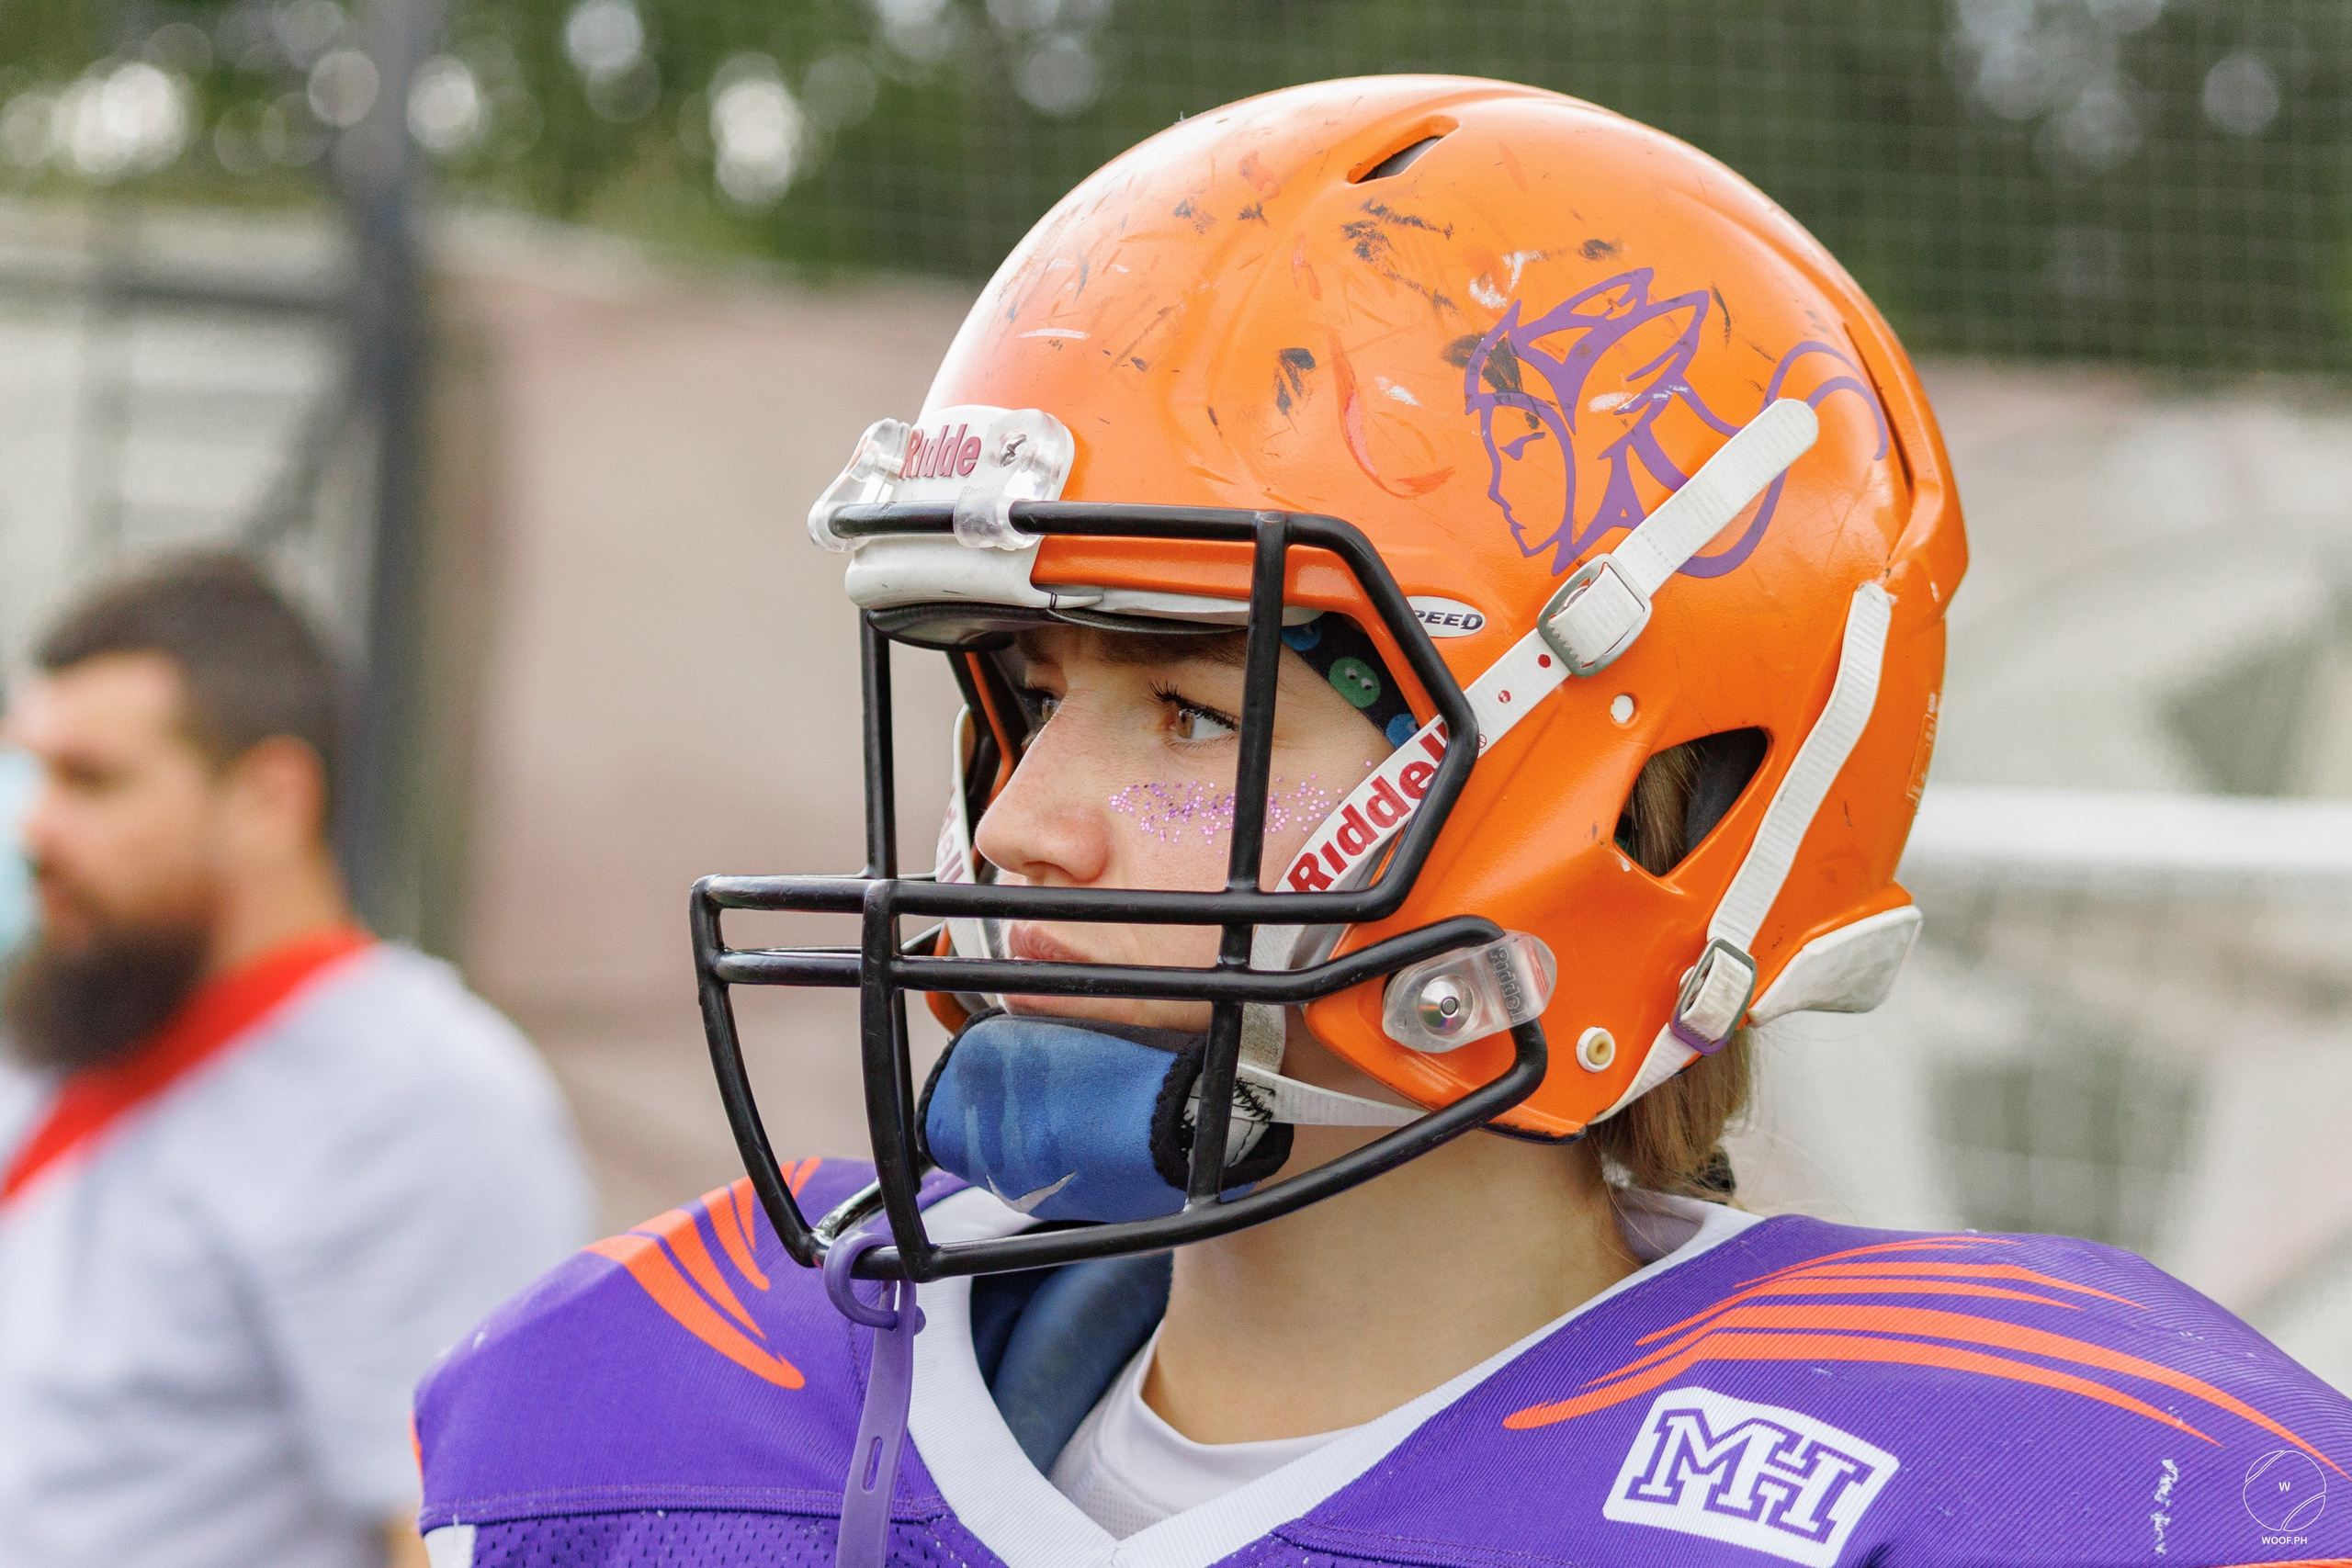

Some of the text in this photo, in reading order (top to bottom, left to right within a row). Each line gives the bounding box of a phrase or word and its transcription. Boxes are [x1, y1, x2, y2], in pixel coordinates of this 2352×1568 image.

[899, 423, 981, 479] Ridde
[1414, 609, 1484, 631] PEED
[1623, 1408, 1877, 1544] MH
